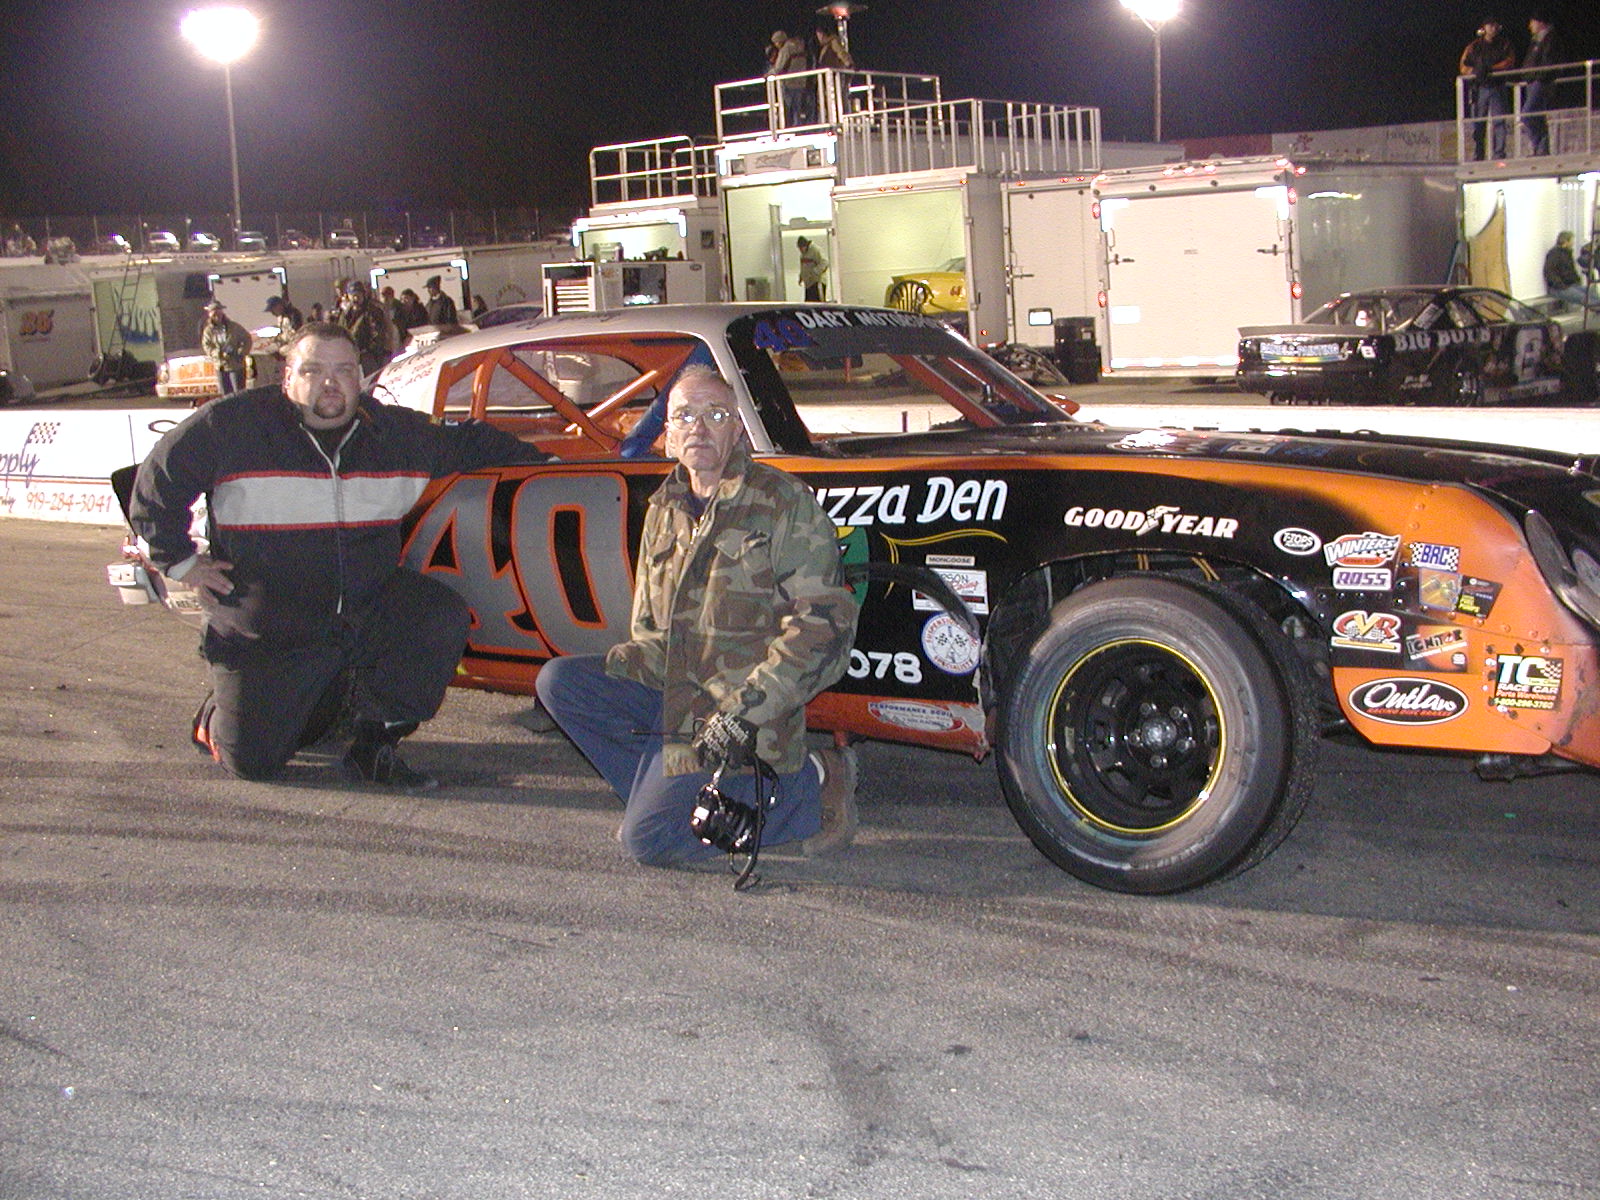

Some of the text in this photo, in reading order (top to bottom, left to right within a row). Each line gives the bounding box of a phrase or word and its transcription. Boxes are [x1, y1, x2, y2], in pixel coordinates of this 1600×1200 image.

[795, 311, 853, 328] DART
[754, 319, 815, 350] 40
[1394, 333, 1431, 351] BIG
[917, 476, 1008, 523] Den
[1064, 506, 1239, 539] GOODYEAR
[928, 556, 972, 564] MONGOOSE
[1326, 538, 1395, 563] WINTERS
[1420, 545, 1450, 565] BRC
[397, 471, 640, 658] 40
[1336, 571, 1389, 586] ROSS
[1336, 613, 1397, 639] CVR
[1498, 655, 1546, 685] TC
[1364, 682, 1457, 711] Outlaw
[1498, 683, 1559, 695] RACE CAR
[869, 702, 927, 714] PERFORMANCE
